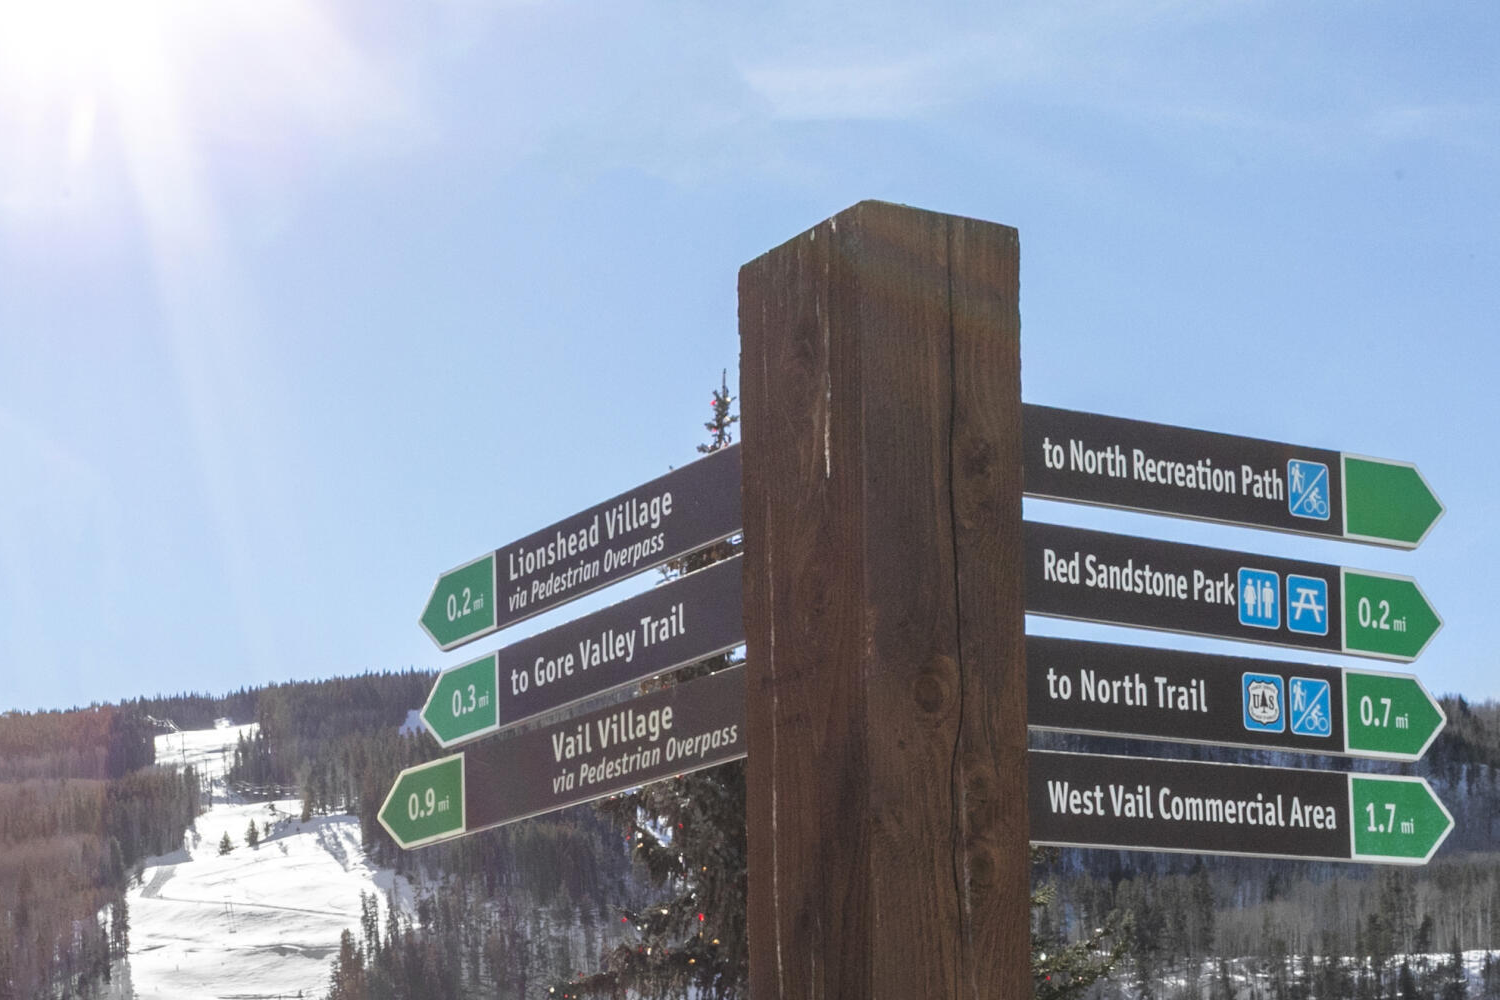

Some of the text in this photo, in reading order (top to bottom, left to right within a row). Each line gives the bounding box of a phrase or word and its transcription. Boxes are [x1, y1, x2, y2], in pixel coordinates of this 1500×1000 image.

[1043, 437, 1284, 500] to North Recreation Path
[509, 491, 672, 581] Lionshead Village
[509, 532, 665, 612] via Pedestrian Overpass
[1044, 549, 1235, 605] Red Sandstone Park
[447, 587, 483, 621] 0.2 mi
[1358, 597, 1406, 632] 0.2 mi
[511, 603, 685, 696] to Gore Valley Trail
[452, 684, 489, 717] 0.3 mi
[1047, 668, 1208, 713] to North Trail
[1360, 696, 1409, 730] 0.7 mi
[552, 706, 673, 763] Vail Village
[553, 723, 738, 794] via Pedestrian Overpass
[408, 788, 449, 822] 0.9 mi
[1048, 781, 1336, 830] West Vail Commercial Area
[1366, 803, 1414, 835] 1.7 mi
